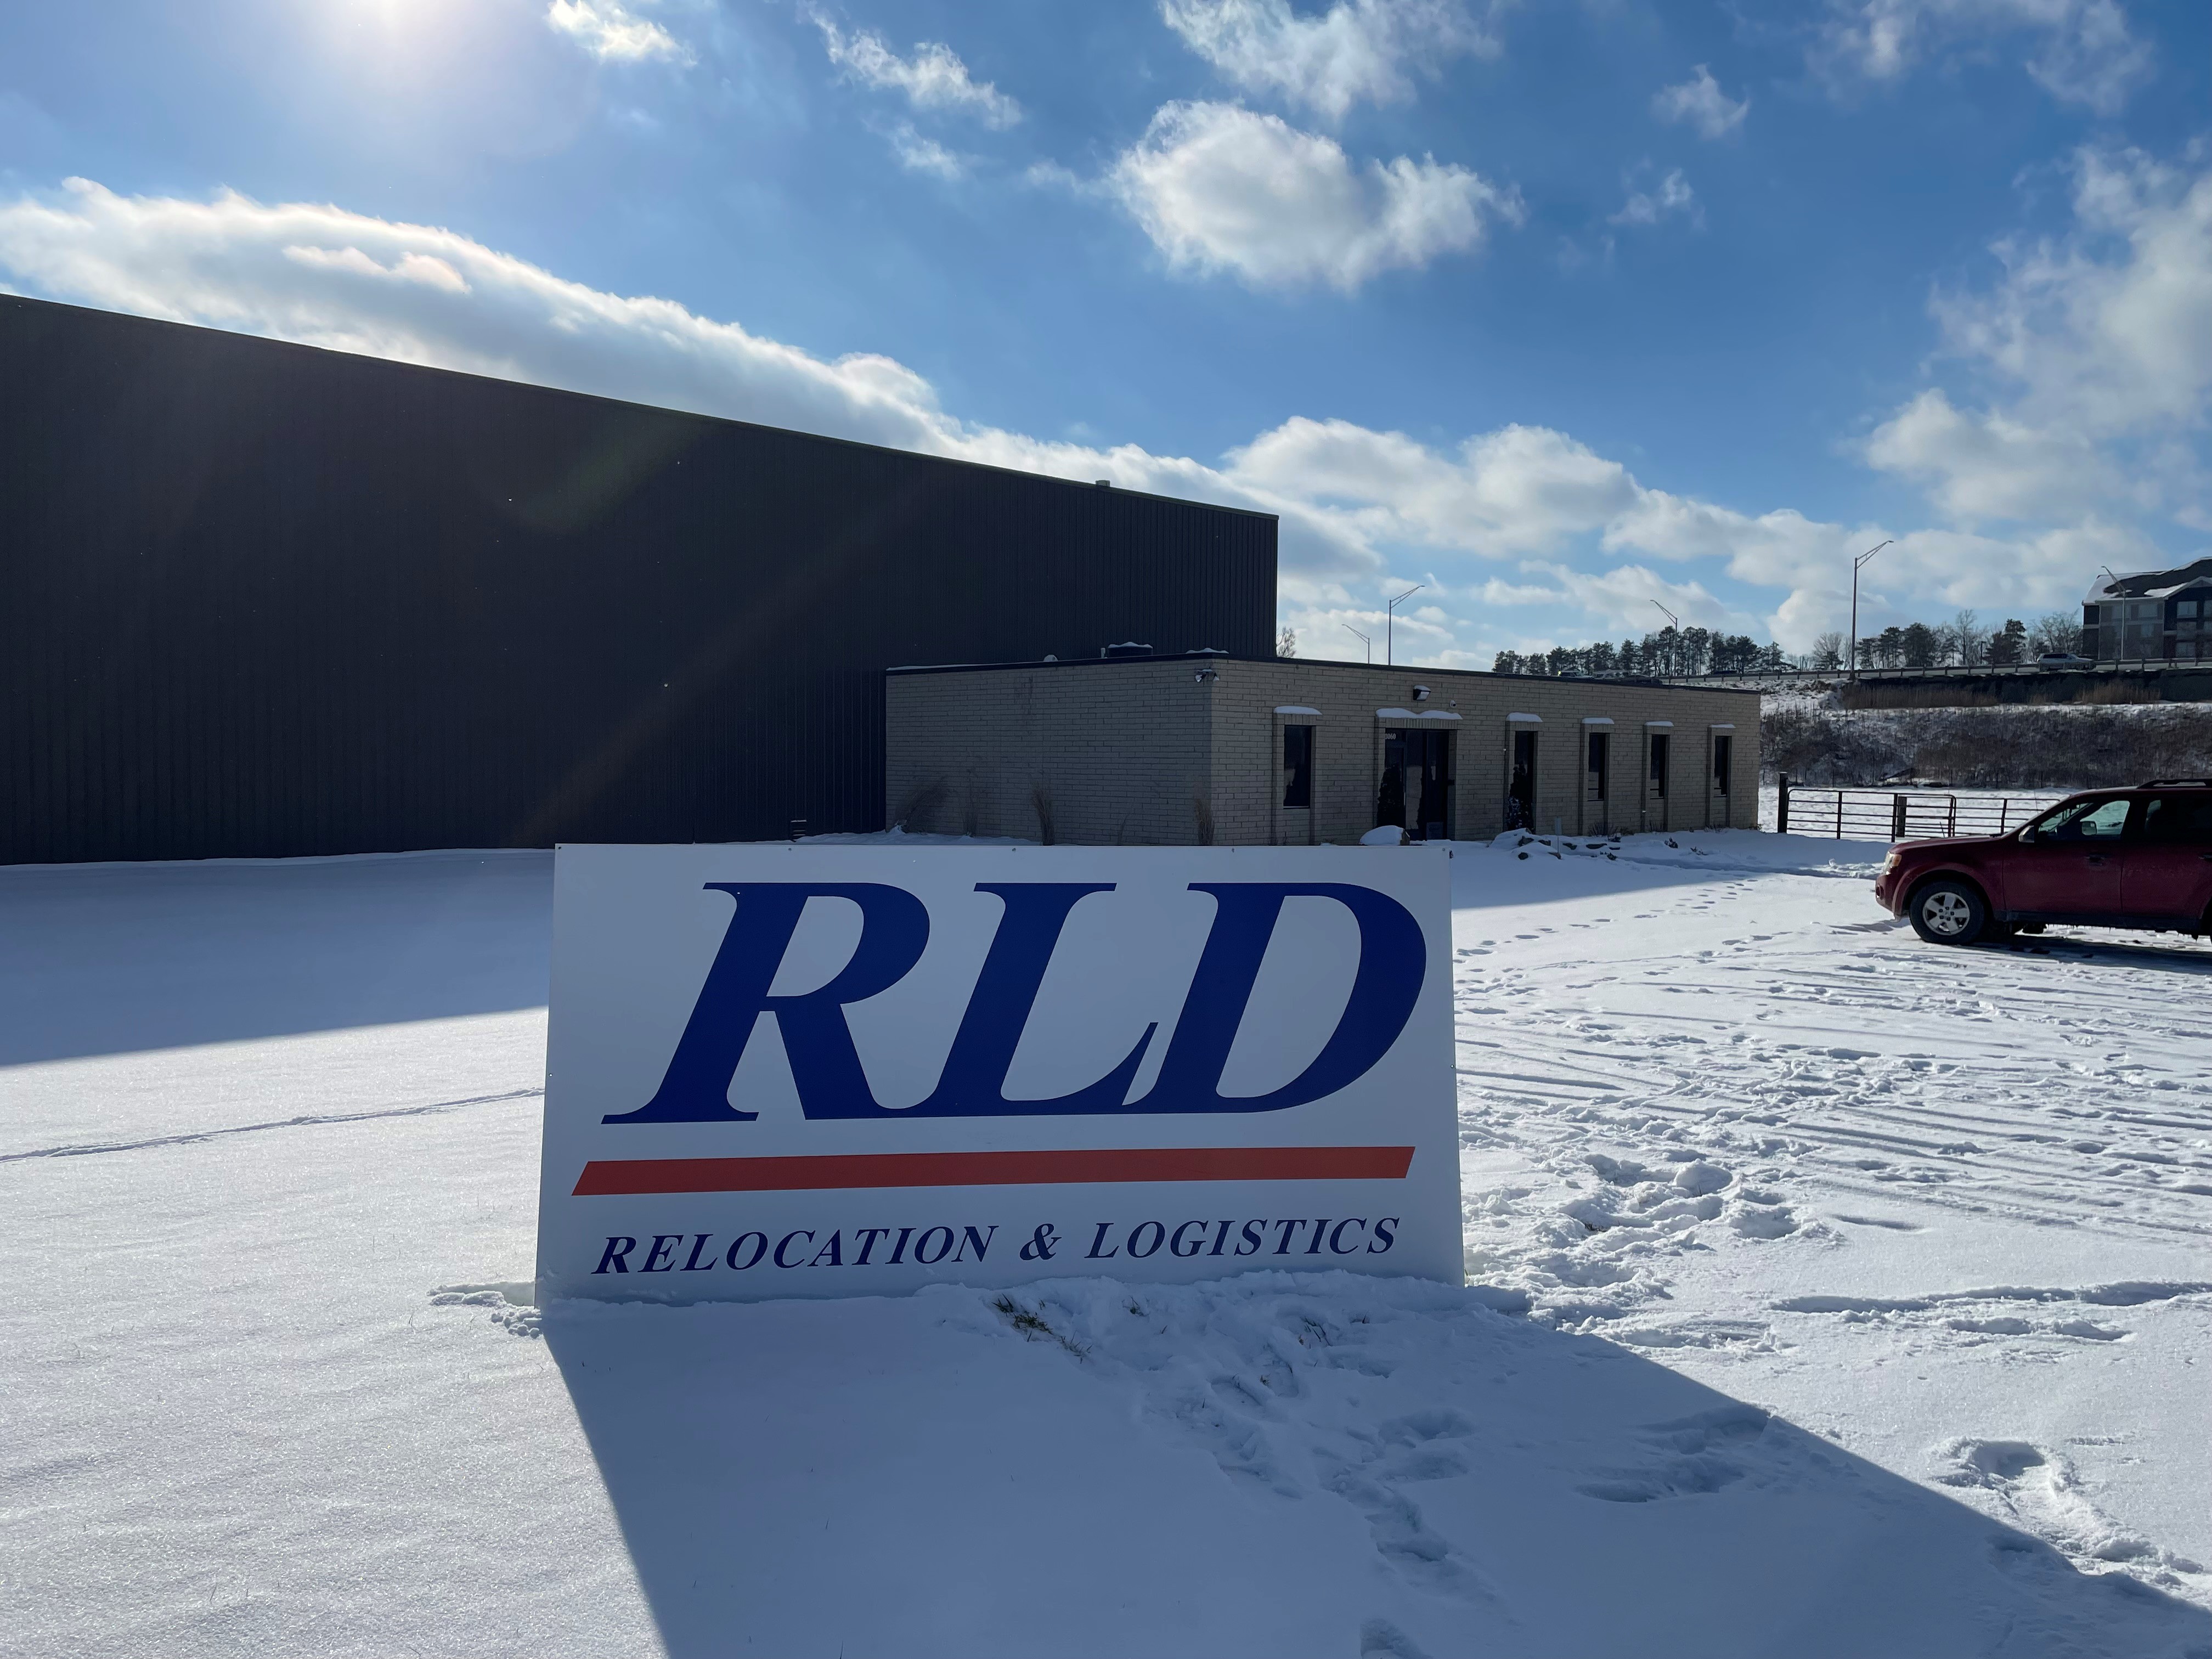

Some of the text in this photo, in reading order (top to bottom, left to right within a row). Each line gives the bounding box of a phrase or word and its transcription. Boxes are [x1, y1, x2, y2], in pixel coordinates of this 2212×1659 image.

[601, 882, 1427, 1124] RLD
[590, 1217, 1401, 1274] RELOCATION & LOGISTICS
